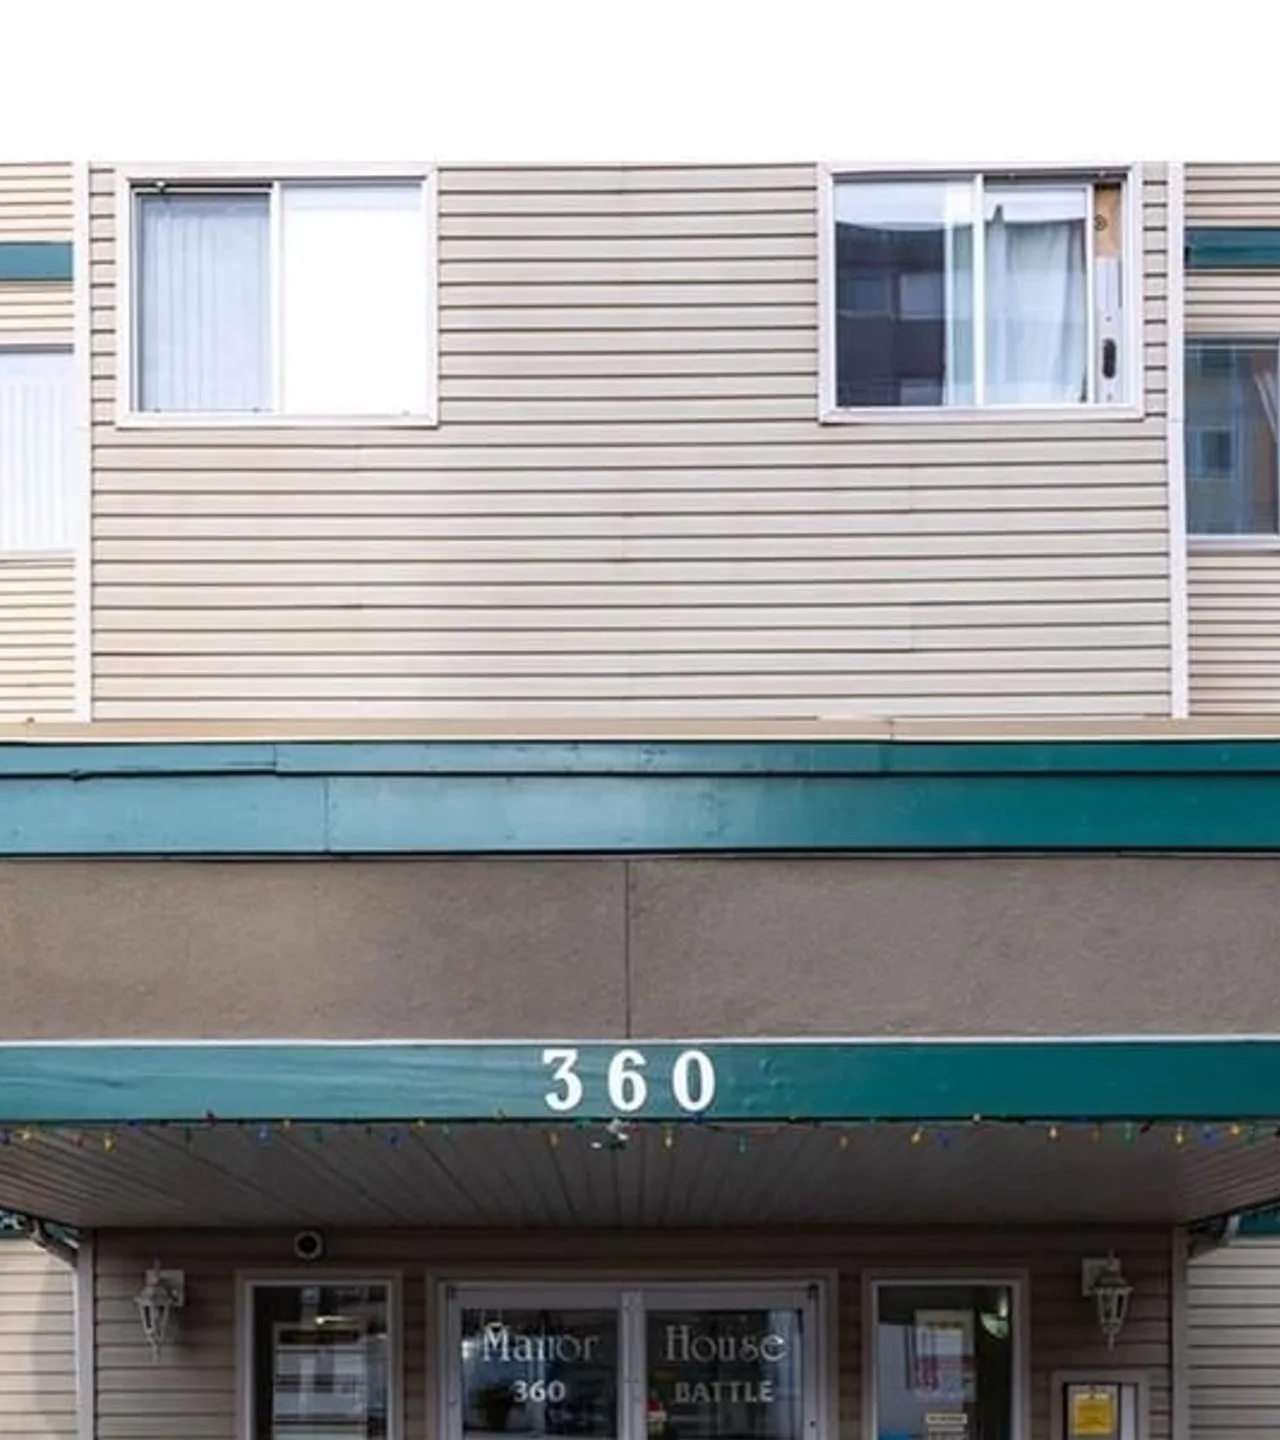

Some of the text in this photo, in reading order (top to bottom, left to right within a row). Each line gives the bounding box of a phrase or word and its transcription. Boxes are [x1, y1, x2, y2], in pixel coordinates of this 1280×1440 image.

[542, 1048, 717, 1112] 360
[482, 1321, 788, 1363] Manor House
[512, 1379, 775, 1403] 360 BATTLE
